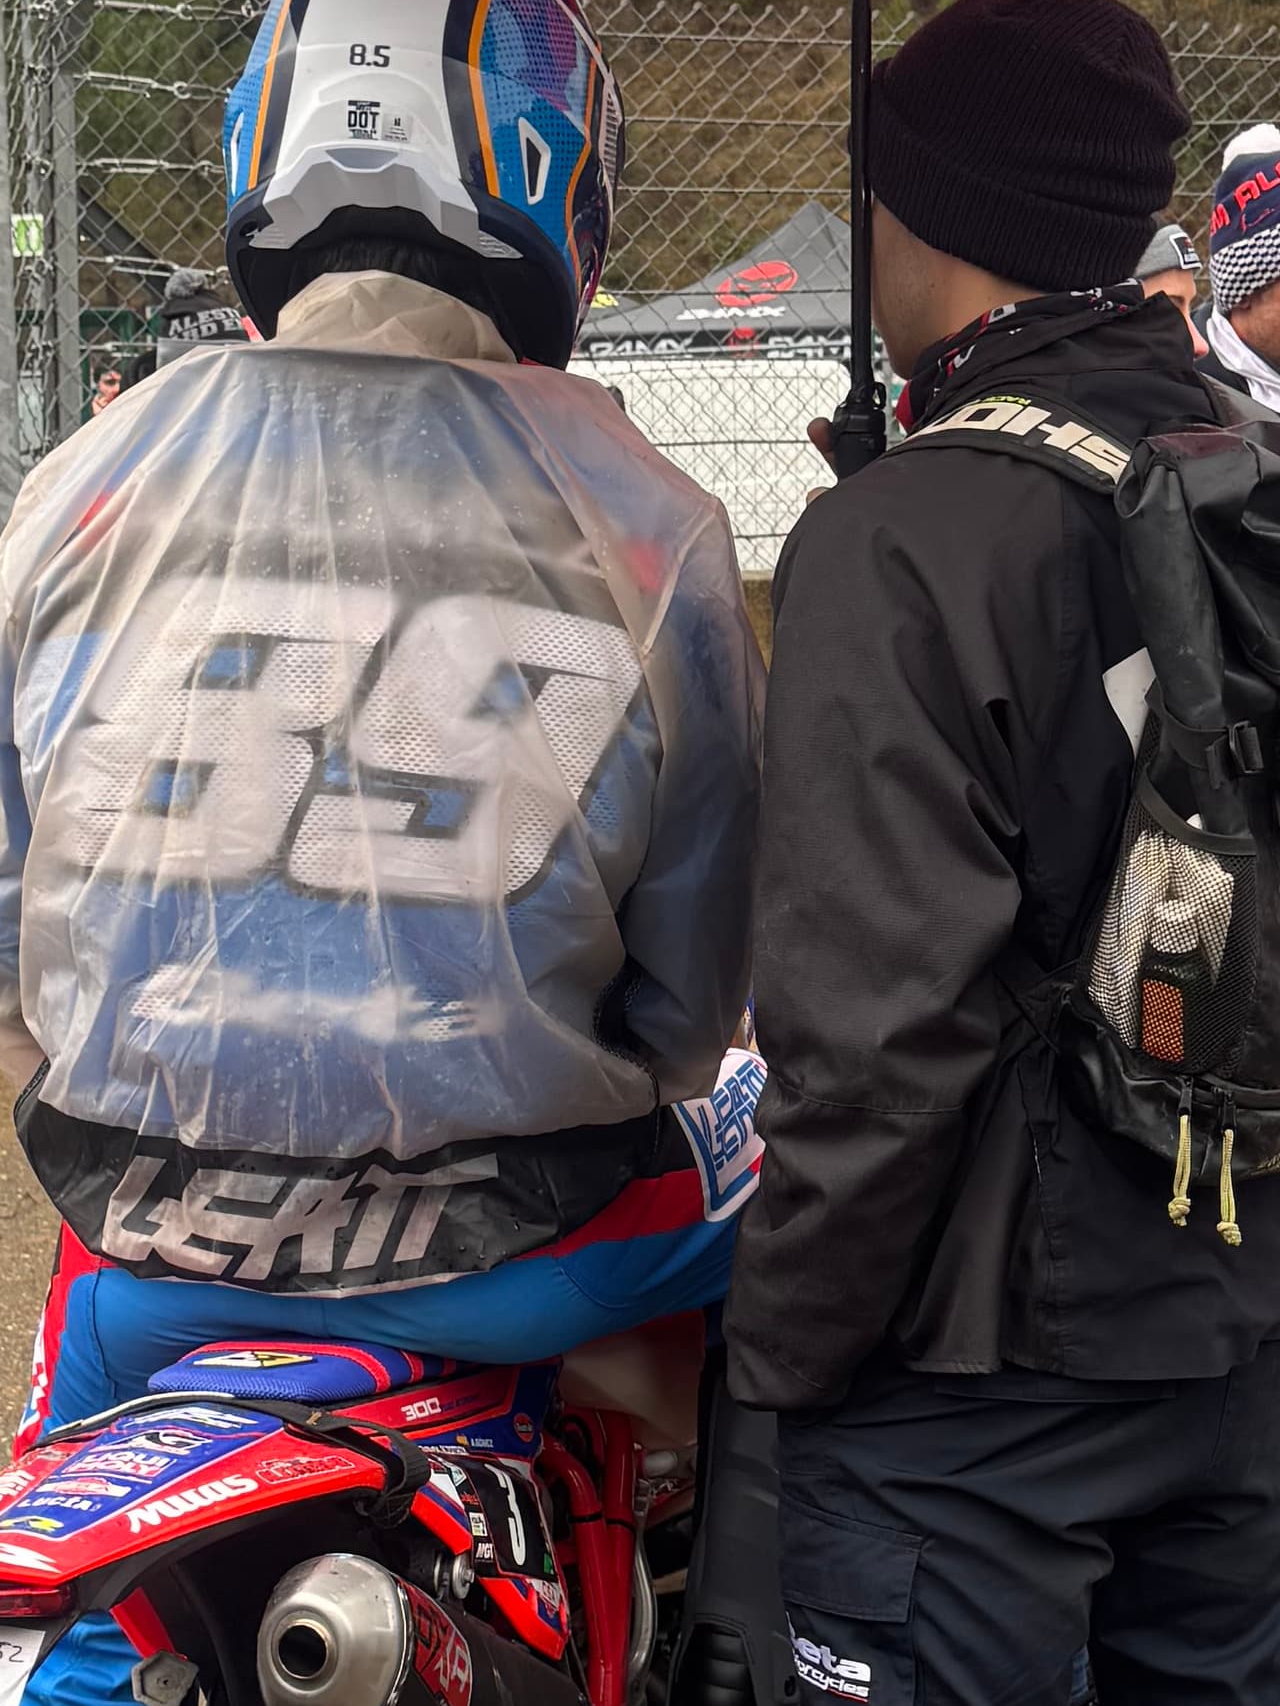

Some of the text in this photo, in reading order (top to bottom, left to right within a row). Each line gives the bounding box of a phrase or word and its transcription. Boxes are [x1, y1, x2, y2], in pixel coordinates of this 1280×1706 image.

[349, 43, 391, 68] 8.5
[348, 110, 380, 130] DOT
[70, 575, 647, 904] 89
[102, 1152, 499, 1278] LEATT
[401, 1396, 442, 1422] 300
[484, 1463, 526, 1566] 3
[786, 1636, 871, 1683] eta
[794, 1653, 870, 1698] orcycles
